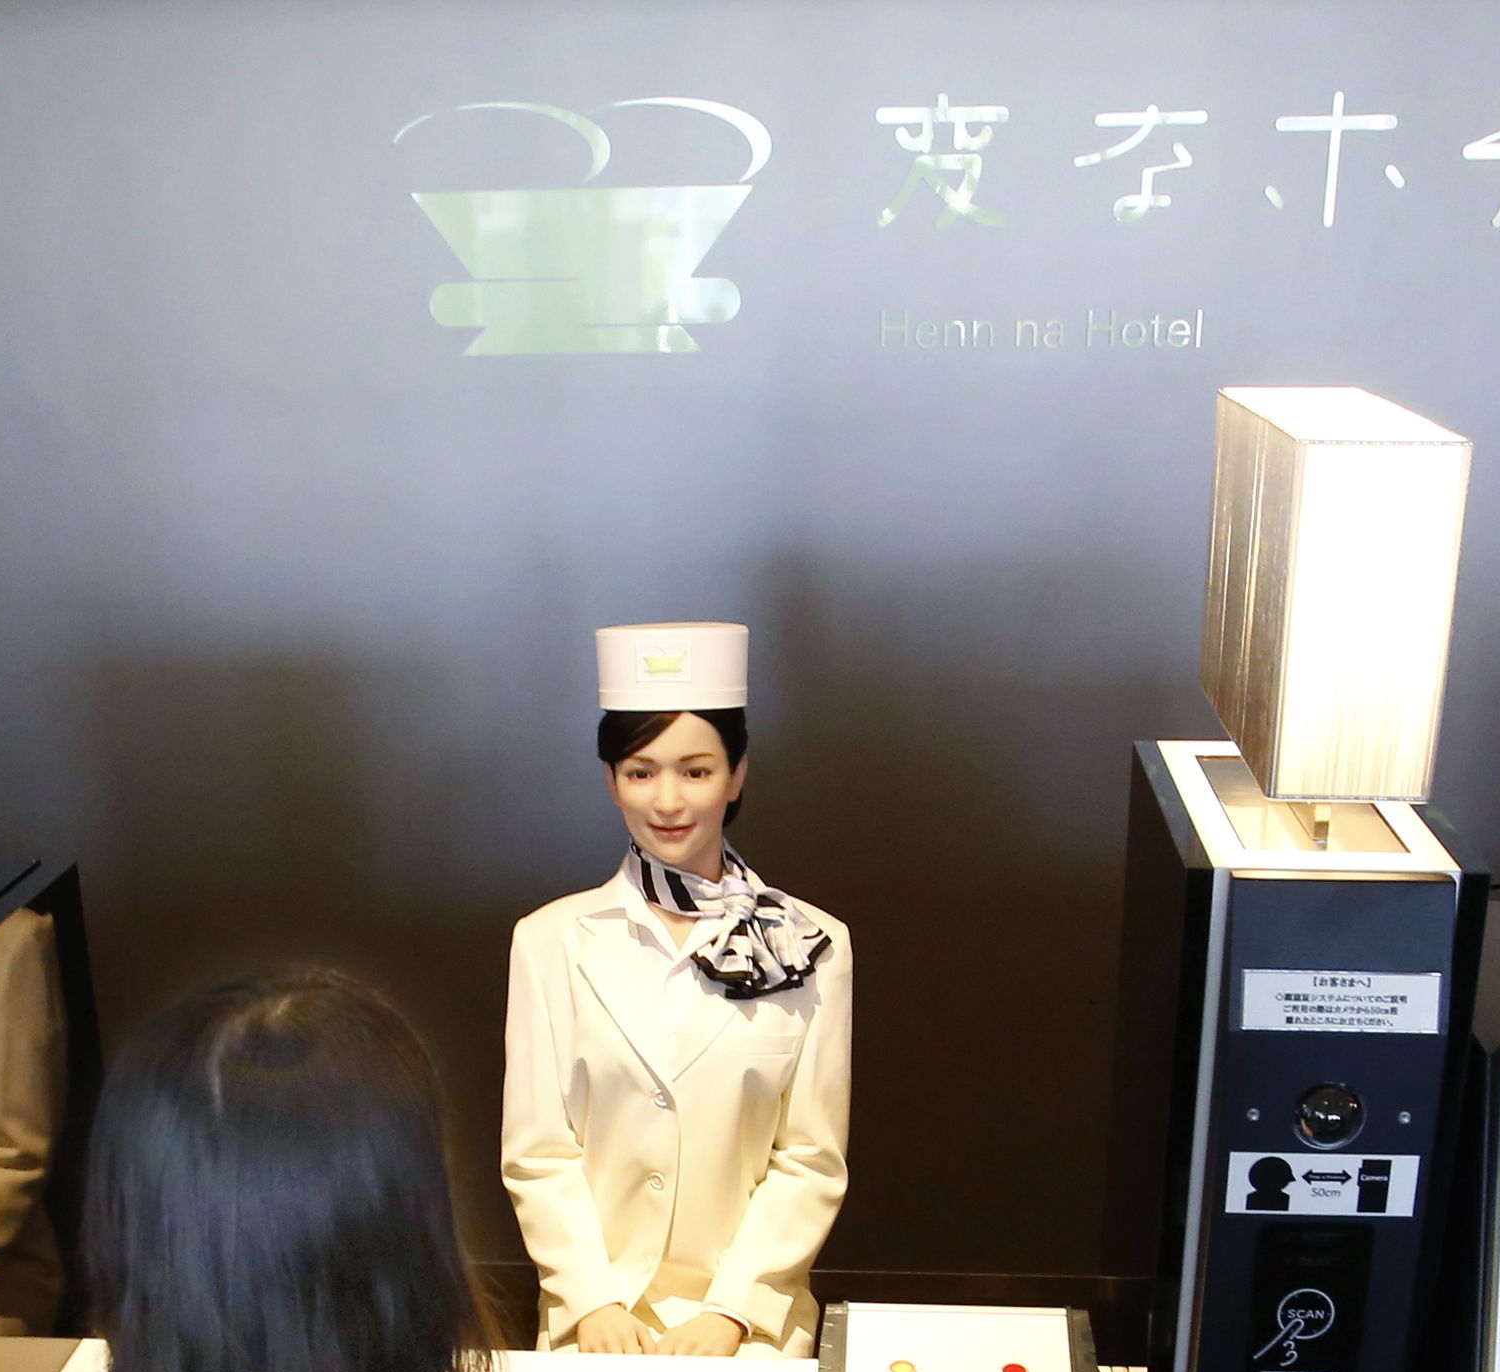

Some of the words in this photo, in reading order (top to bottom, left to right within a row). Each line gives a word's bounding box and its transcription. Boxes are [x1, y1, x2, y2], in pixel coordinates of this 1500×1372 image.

[879, 308, 997, 349] Henn
[1014, 318, 1066, 349] na
[1087, 308, 1205, 349] Hotel
[1311, 1187, 1341, 1198] 50cm
[1286, 1308, 1326, 1320] SCAN
